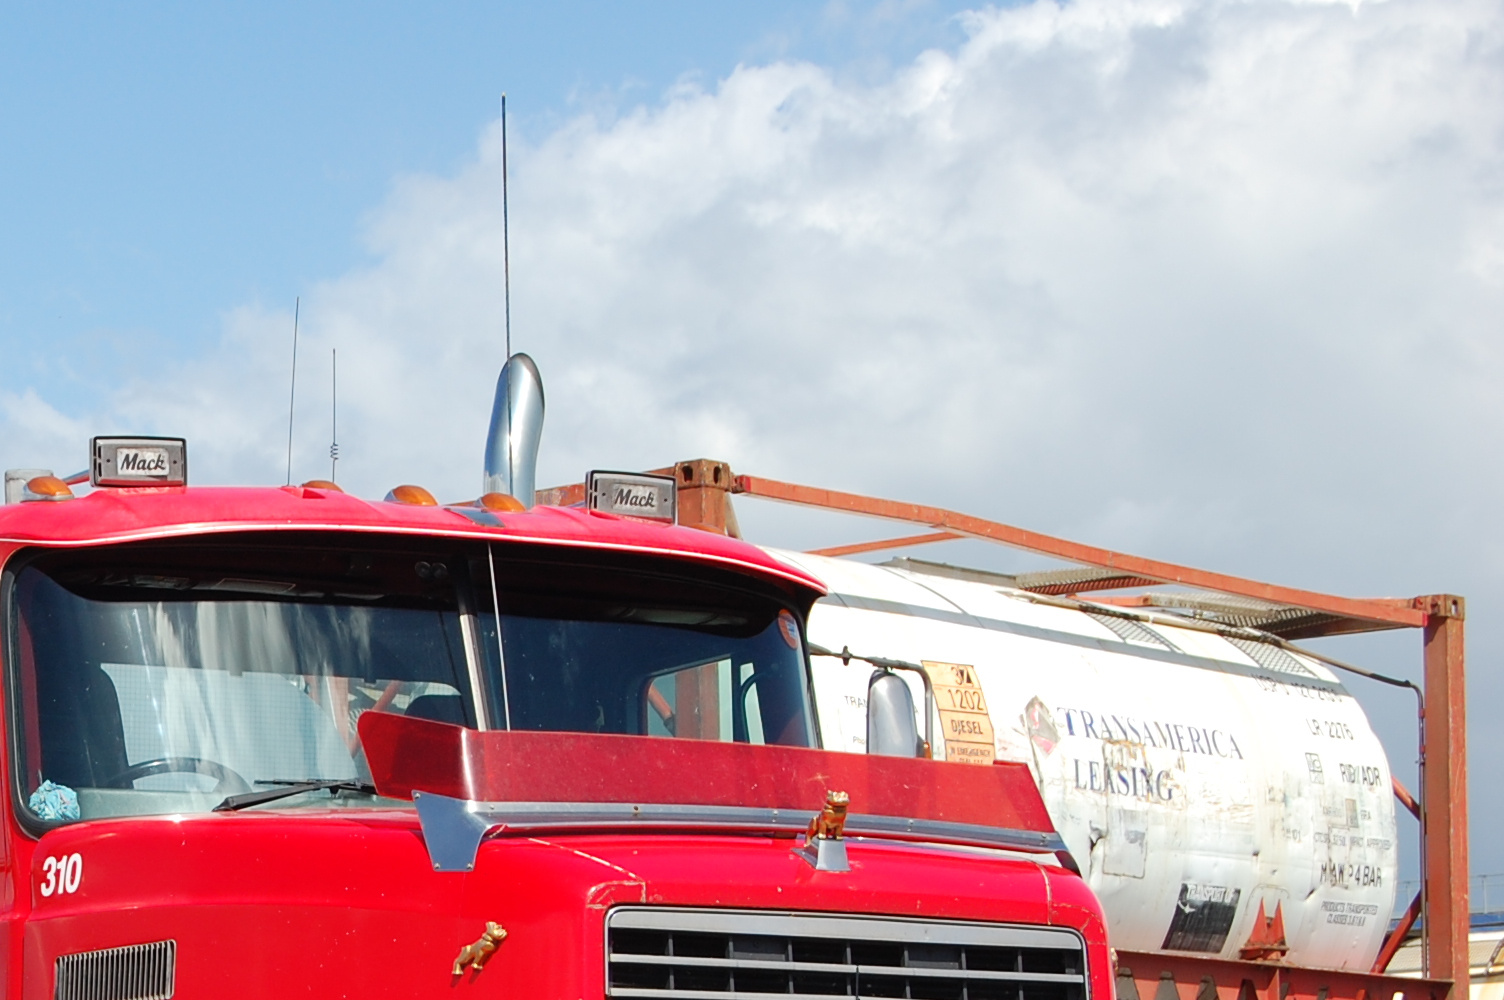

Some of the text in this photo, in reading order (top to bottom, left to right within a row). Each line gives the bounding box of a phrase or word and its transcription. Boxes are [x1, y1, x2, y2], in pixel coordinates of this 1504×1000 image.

[120, 452, 167, 471] Mack
[614, 488, 656, 508] Mack
[948, 688, 984, 711] 1202
[950, 719, 984, 735] DIESEL
[1056, 706, 1244, 760] TRANSAMERICA
[1073, 758, 1173, 801] LEASING
[40, 852, 83, 897] 310
[1362, 865, 1383, 888] BAR
